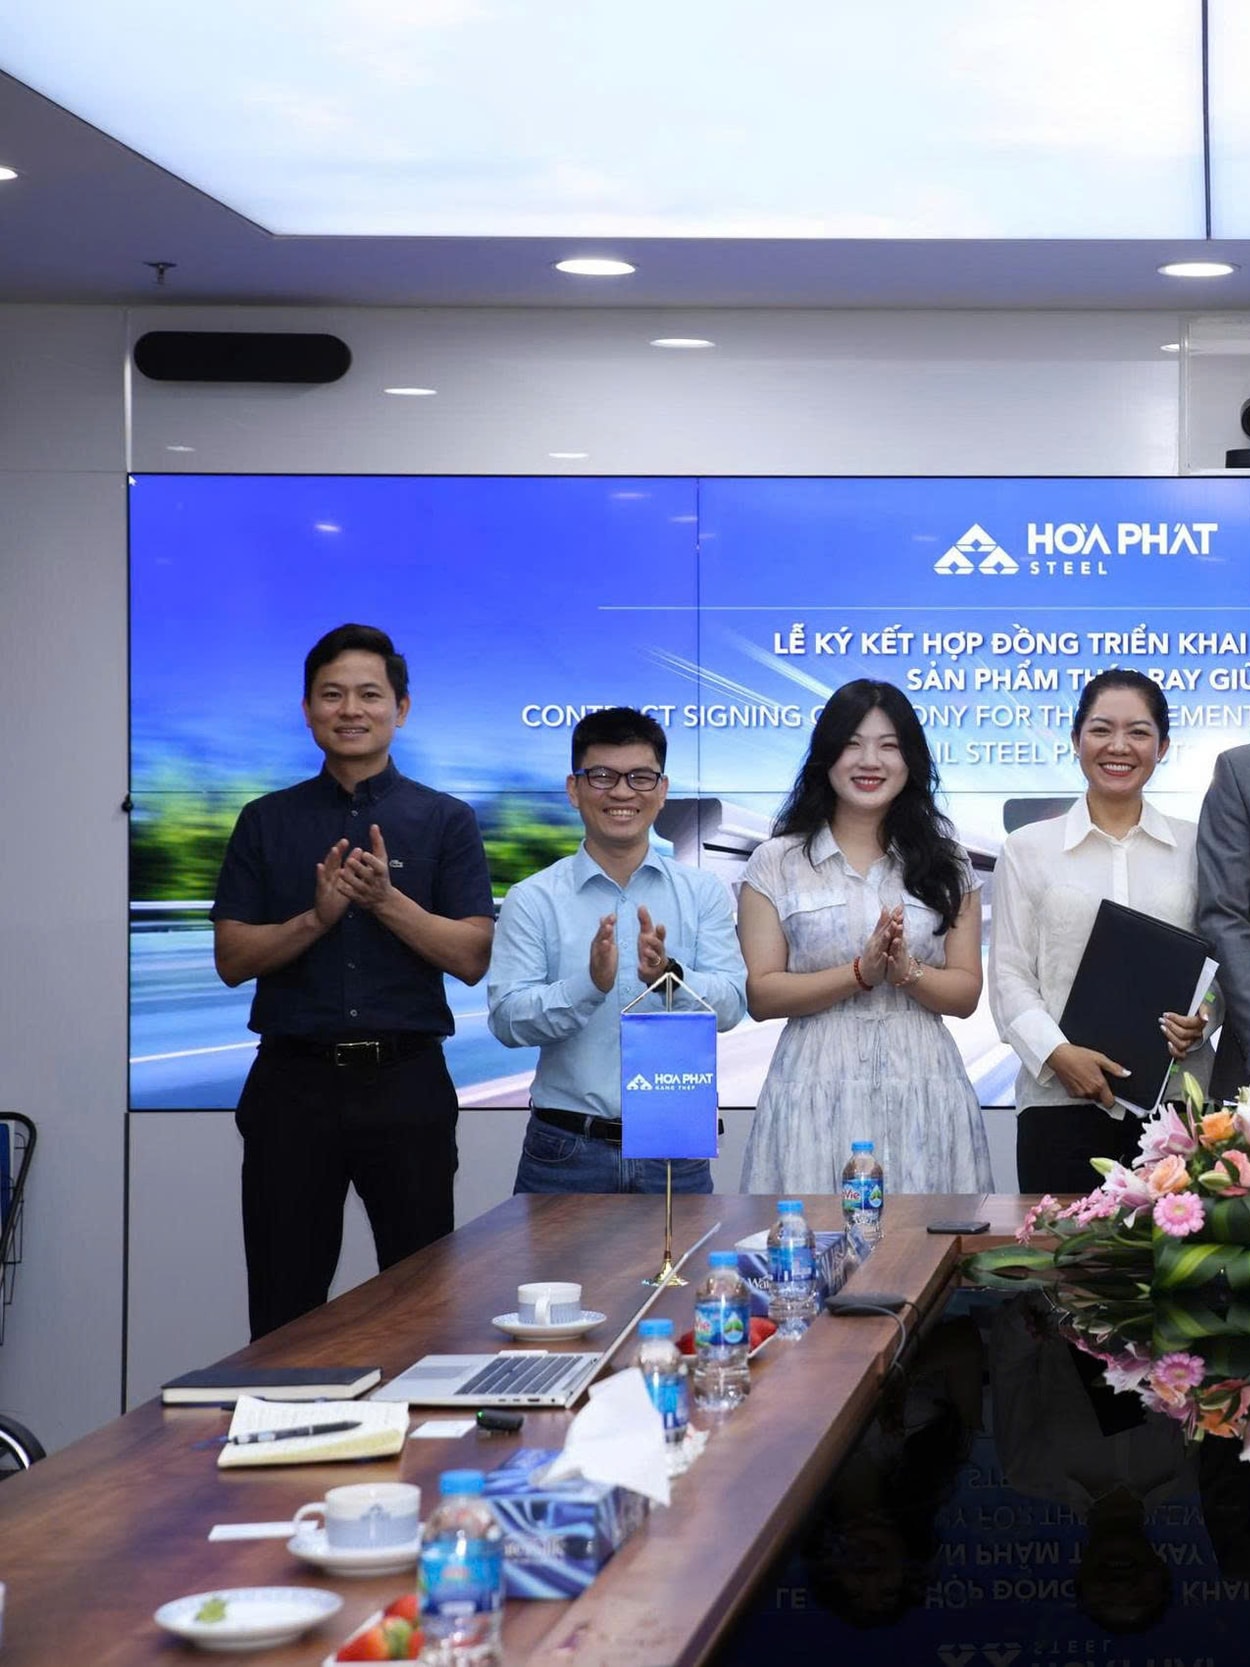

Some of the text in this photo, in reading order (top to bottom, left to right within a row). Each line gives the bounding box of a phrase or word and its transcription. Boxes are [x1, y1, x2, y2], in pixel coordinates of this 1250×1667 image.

[1118, 523, 1218, 555] PHÁT
[1030, 561, 1107, 575] STEEL
[774, 623, 806, 655] LỄ
[815, 626, 853, 655] KÝ
[861, 624, 914, 655] KẾT
[922, 630, 983, 661] HỢP
[991, 624, 1079, 655] ĐỒNG
[1087, 623, 1169, 655] TRIỂN
[1179, 632, 1248, 655] KHAI
[906, 660, 965, 691] SẢN
[974, 658, 1059, 691] PHẨM
[1149, 668, 1203, 691] RAY
[683, 704, 802, 727] SIGNING
[976, 704, 1031, 727] FOR
[1039, 705, 1074, 726] TH
[966, 741, 1045, 765] STEEL
